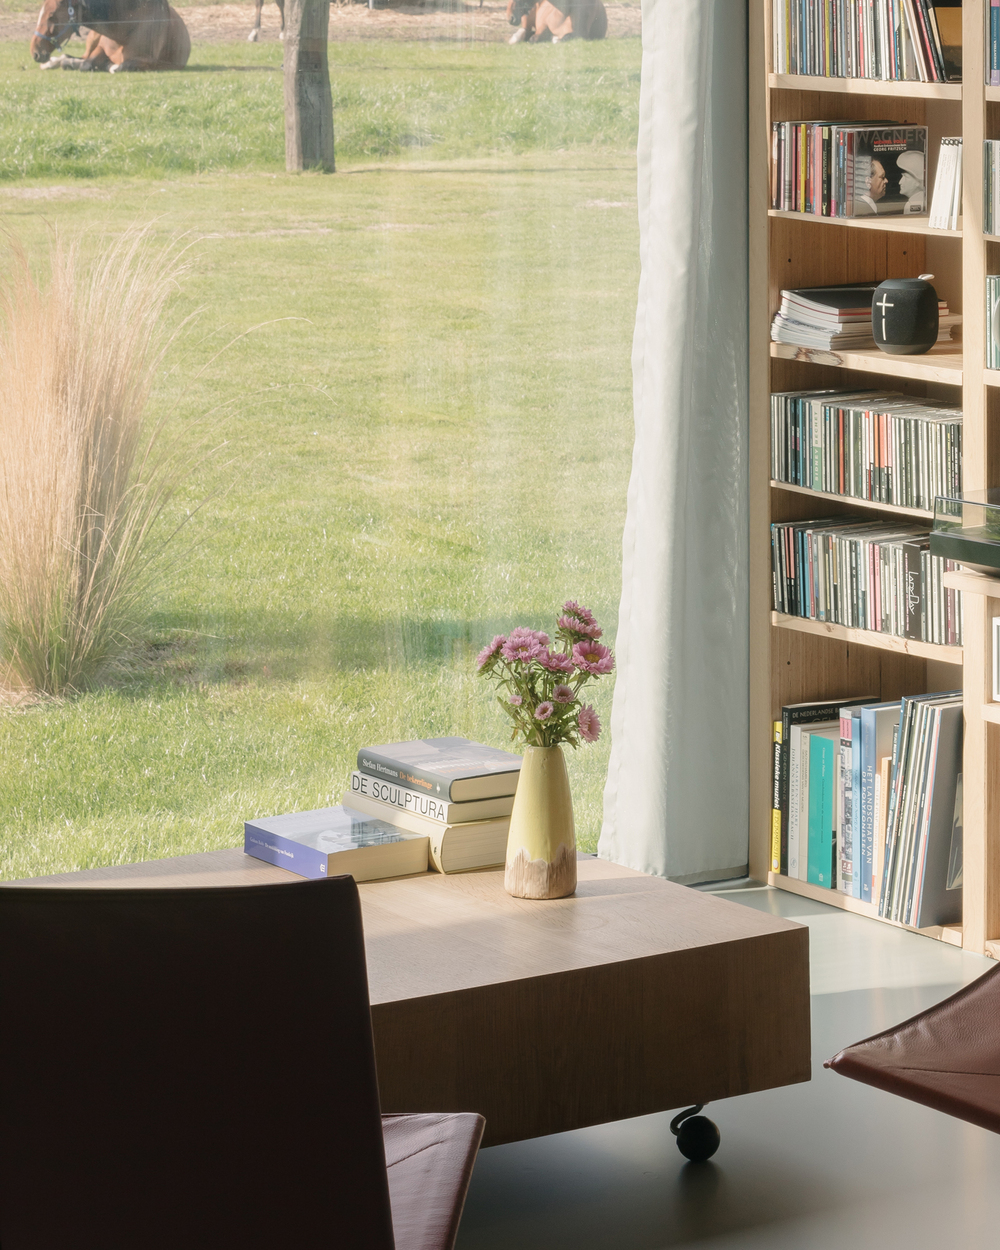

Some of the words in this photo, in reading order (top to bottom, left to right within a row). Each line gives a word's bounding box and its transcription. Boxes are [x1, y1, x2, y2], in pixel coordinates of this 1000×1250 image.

[856, 129, 925, 143] WAGNER
[362, 758, 376, 770] Stefan
[399, 771, 407, 780] De
[406, 774, 433, 790] bekeerlinge
[861, 771, 867, 783] DE
[351, 775, 368, 794] DE
[372, 784, 446, 820] SCULPTURA
